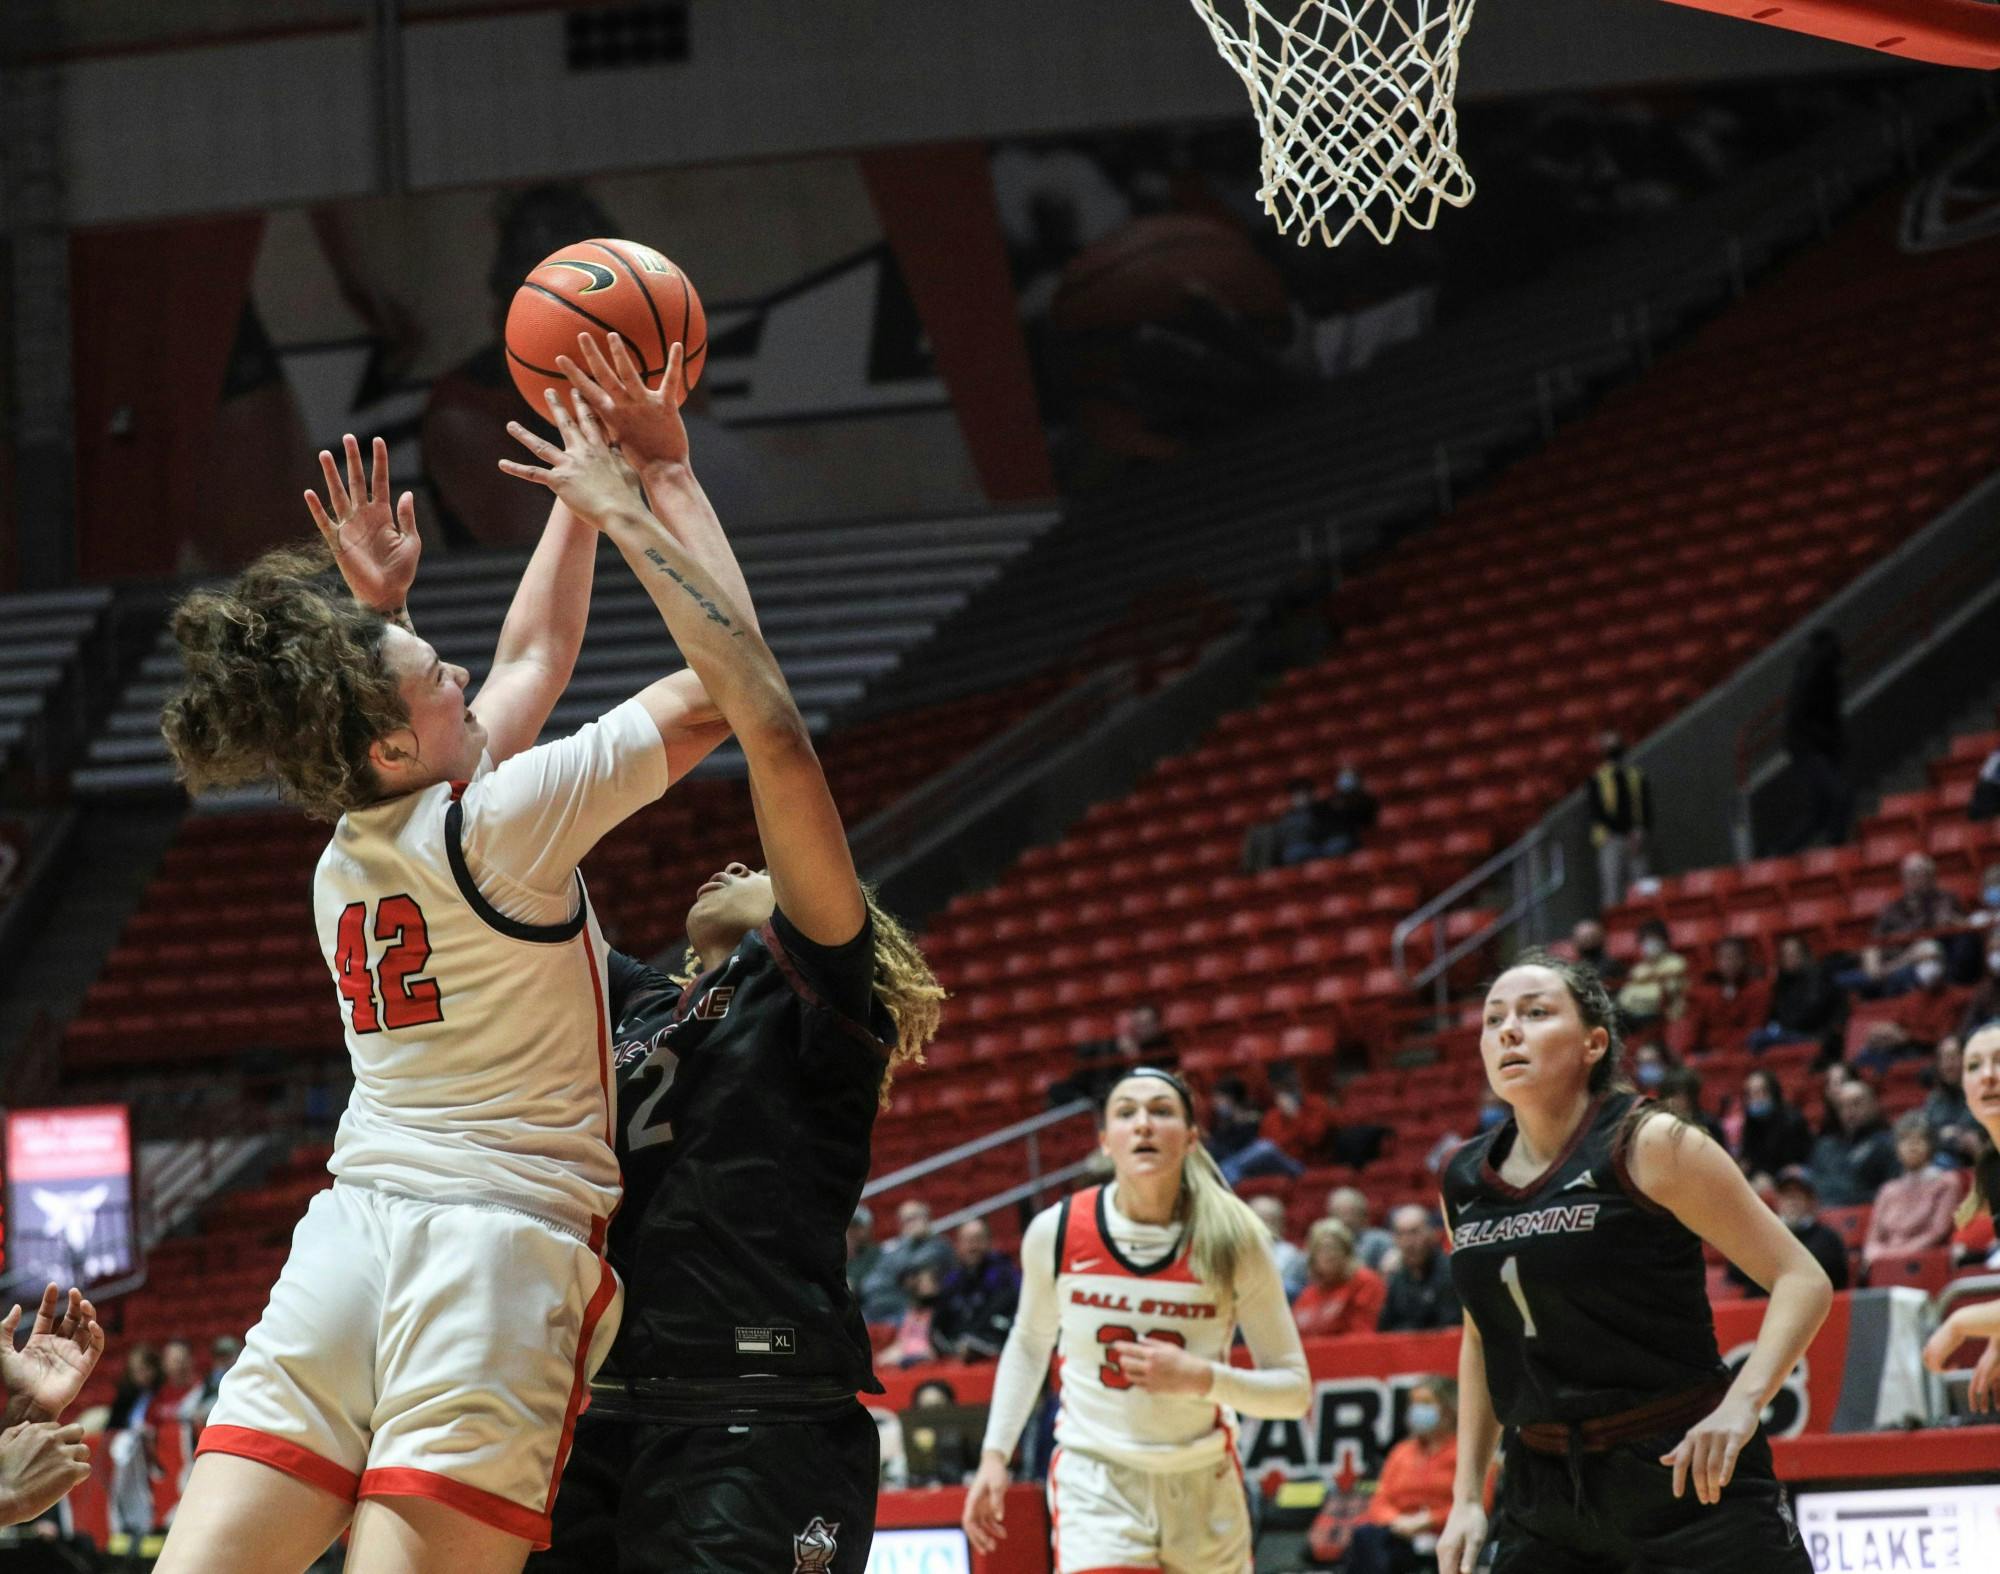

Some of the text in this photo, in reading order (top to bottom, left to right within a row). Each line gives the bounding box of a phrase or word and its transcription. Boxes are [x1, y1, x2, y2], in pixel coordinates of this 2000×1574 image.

[334, 893, 444, 1034] 42
[627, 1047, 680, 1152] 2
[1455, 1204, 1600, 1250] ELLARMINE
[1071, 1290, 1216, 1319] BALL STATE
[1501, 1256, 1537, 1337] 1
[775, 1335, 790, 1347] XL
[1096, 1324, 1186, 1390] 3
[1810, 1526, 1936, 1572] BLAKE
